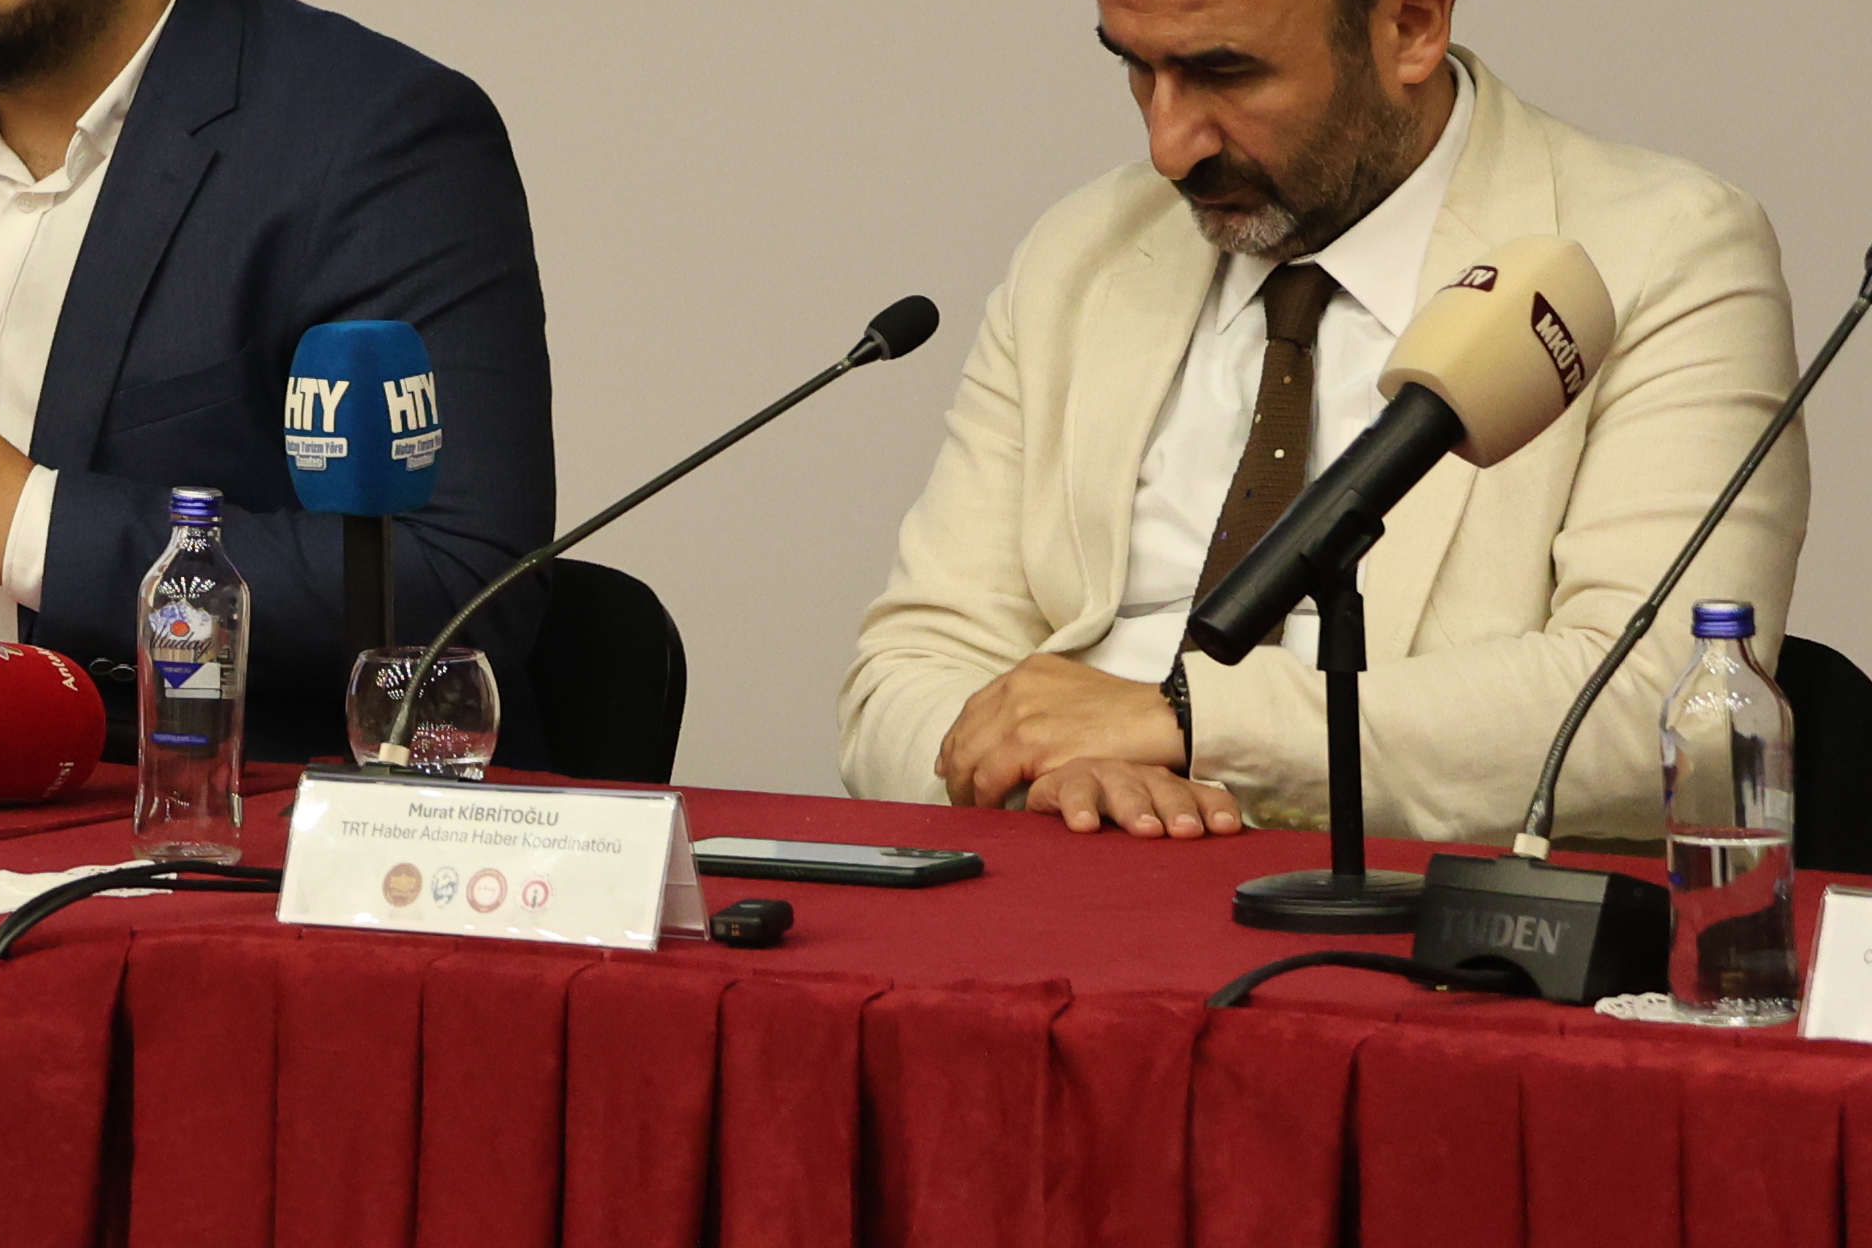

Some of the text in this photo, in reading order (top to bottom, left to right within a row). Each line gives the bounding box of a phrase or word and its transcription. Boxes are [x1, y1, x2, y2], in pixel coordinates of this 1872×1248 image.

[284, 375, 351, 434] HTY
[383, 371, 439, 434] HTY
[341, 820, 622, 854] TRT Haber Adana Haber Koordinatörü
[408, 802, 560, 826] Murat KİBRİTOĞLU
